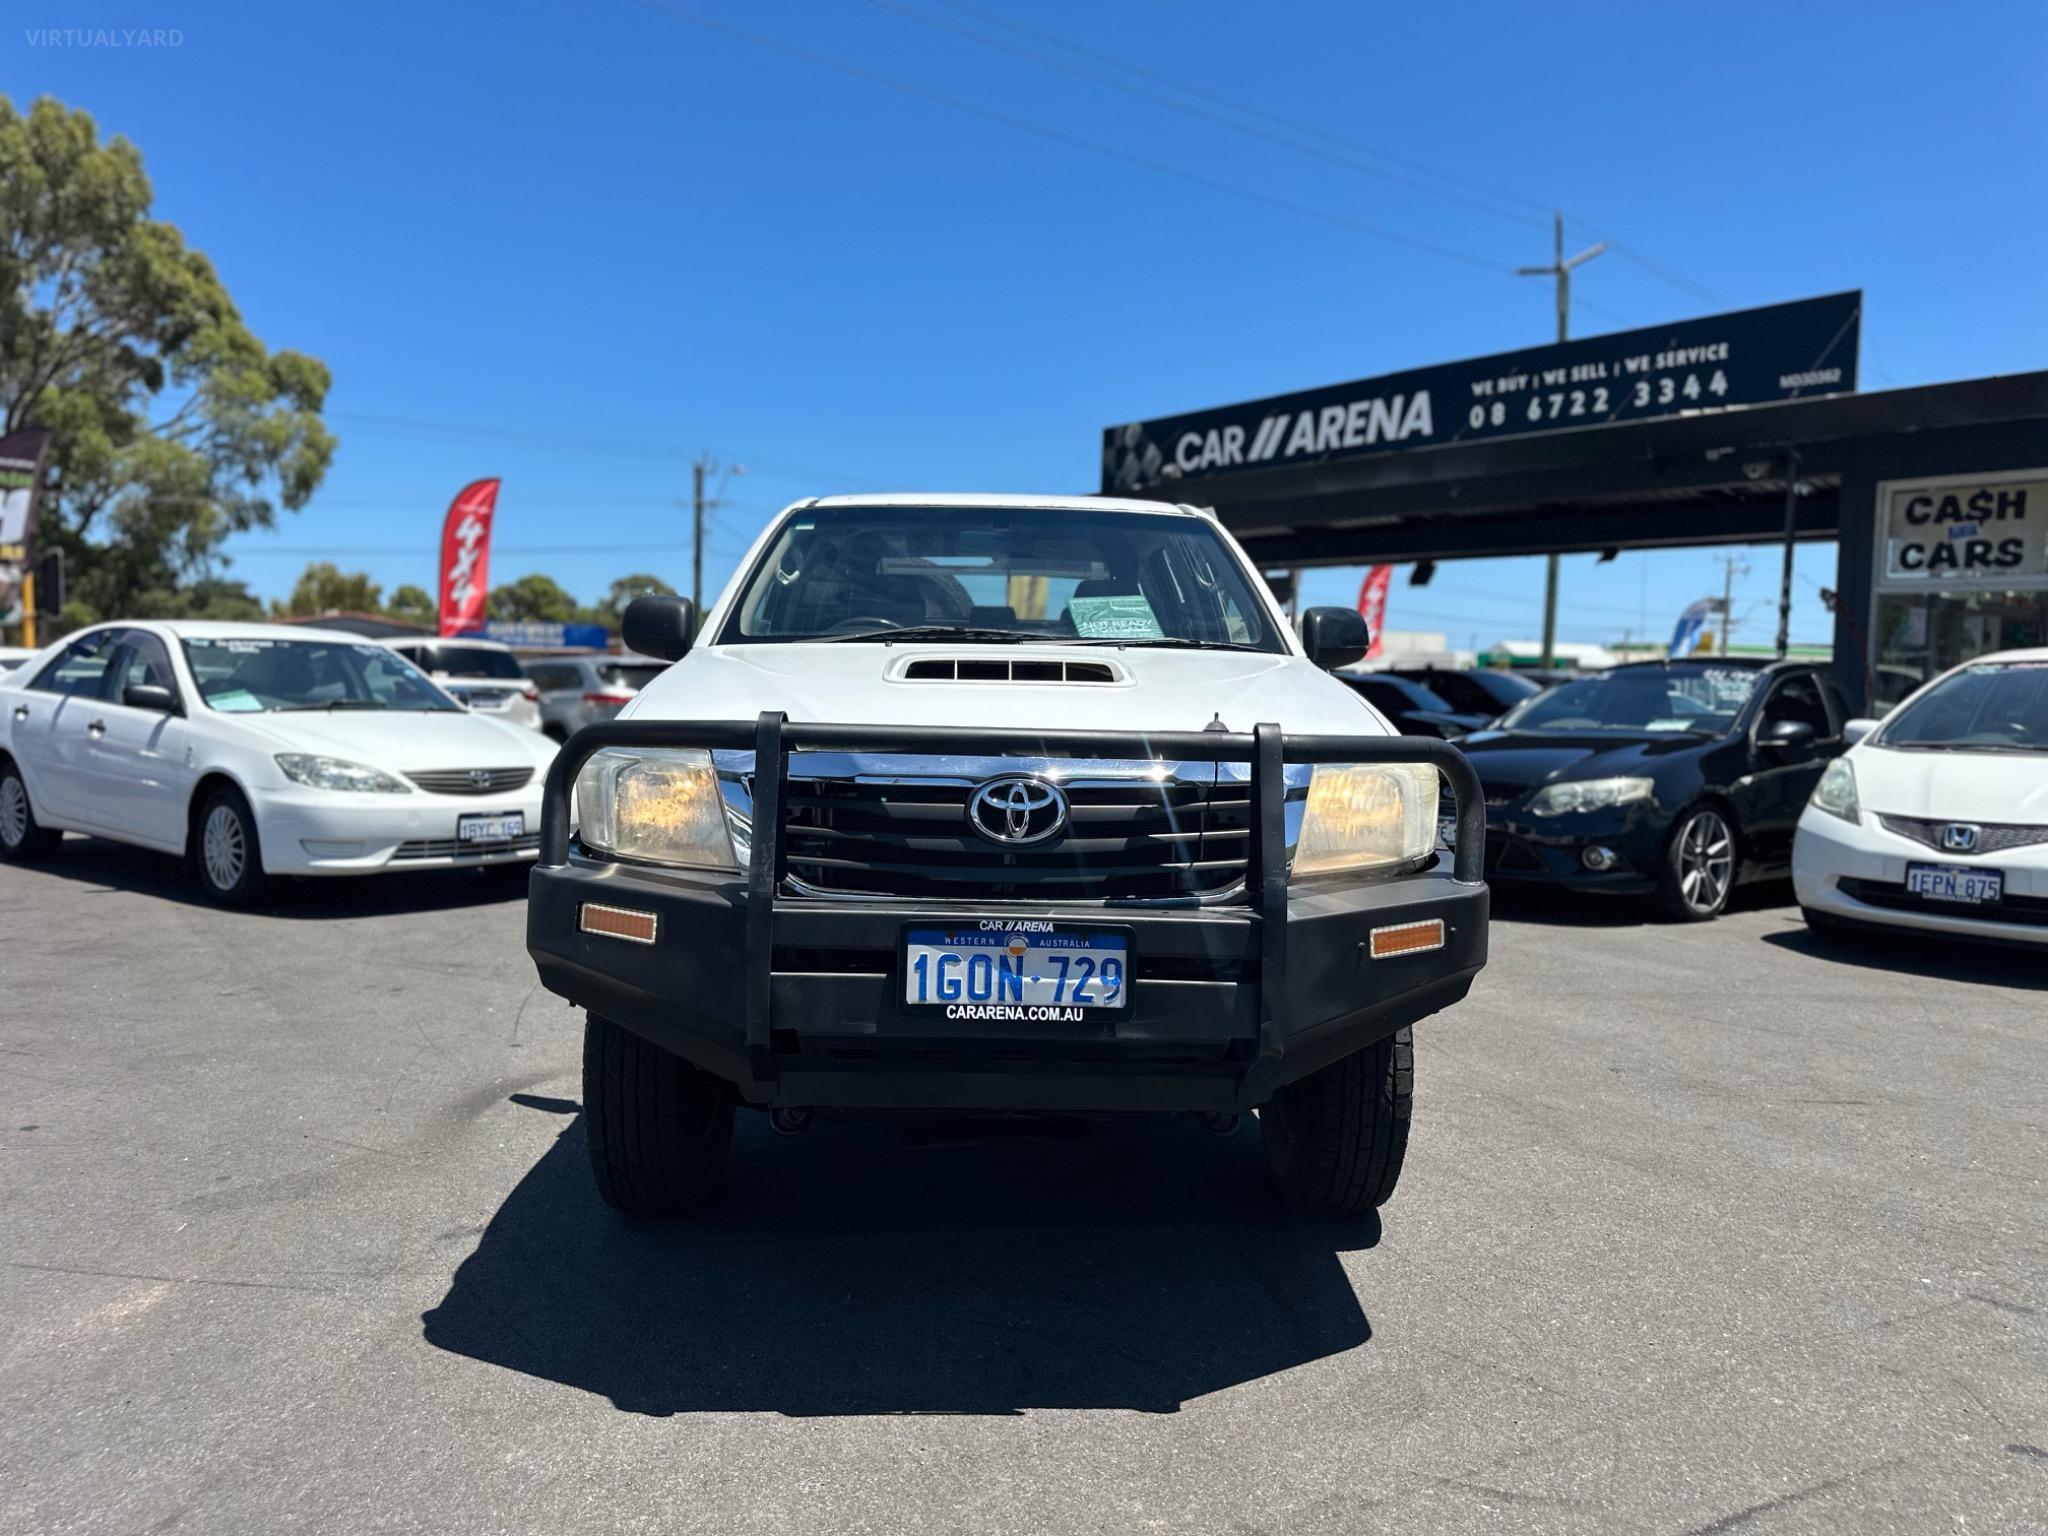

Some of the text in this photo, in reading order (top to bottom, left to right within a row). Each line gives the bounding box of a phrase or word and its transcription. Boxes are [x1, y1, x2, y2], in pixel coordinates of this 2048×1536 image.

[1470, 380, 1493, 397] WE
[1497, 374, 1528, 393] BUY
[1542, 368, 1567, 386] WE
[1571, 362, 1608, 382] SELL
[1624, 355, 1650, 373] WE
[1656, 342, 1729, 370] SERVICE
[1469, 370, 1728, 429] 08 6722 3344
[1900, 538, 2024, 569] CARS
[1083, 620, 1152, 629] NOT READY
[944, 937, 1090, 948] WESTERN AUSTRALIA
[946, 1005, 1083, 1021] CARARENA.COM.AU
